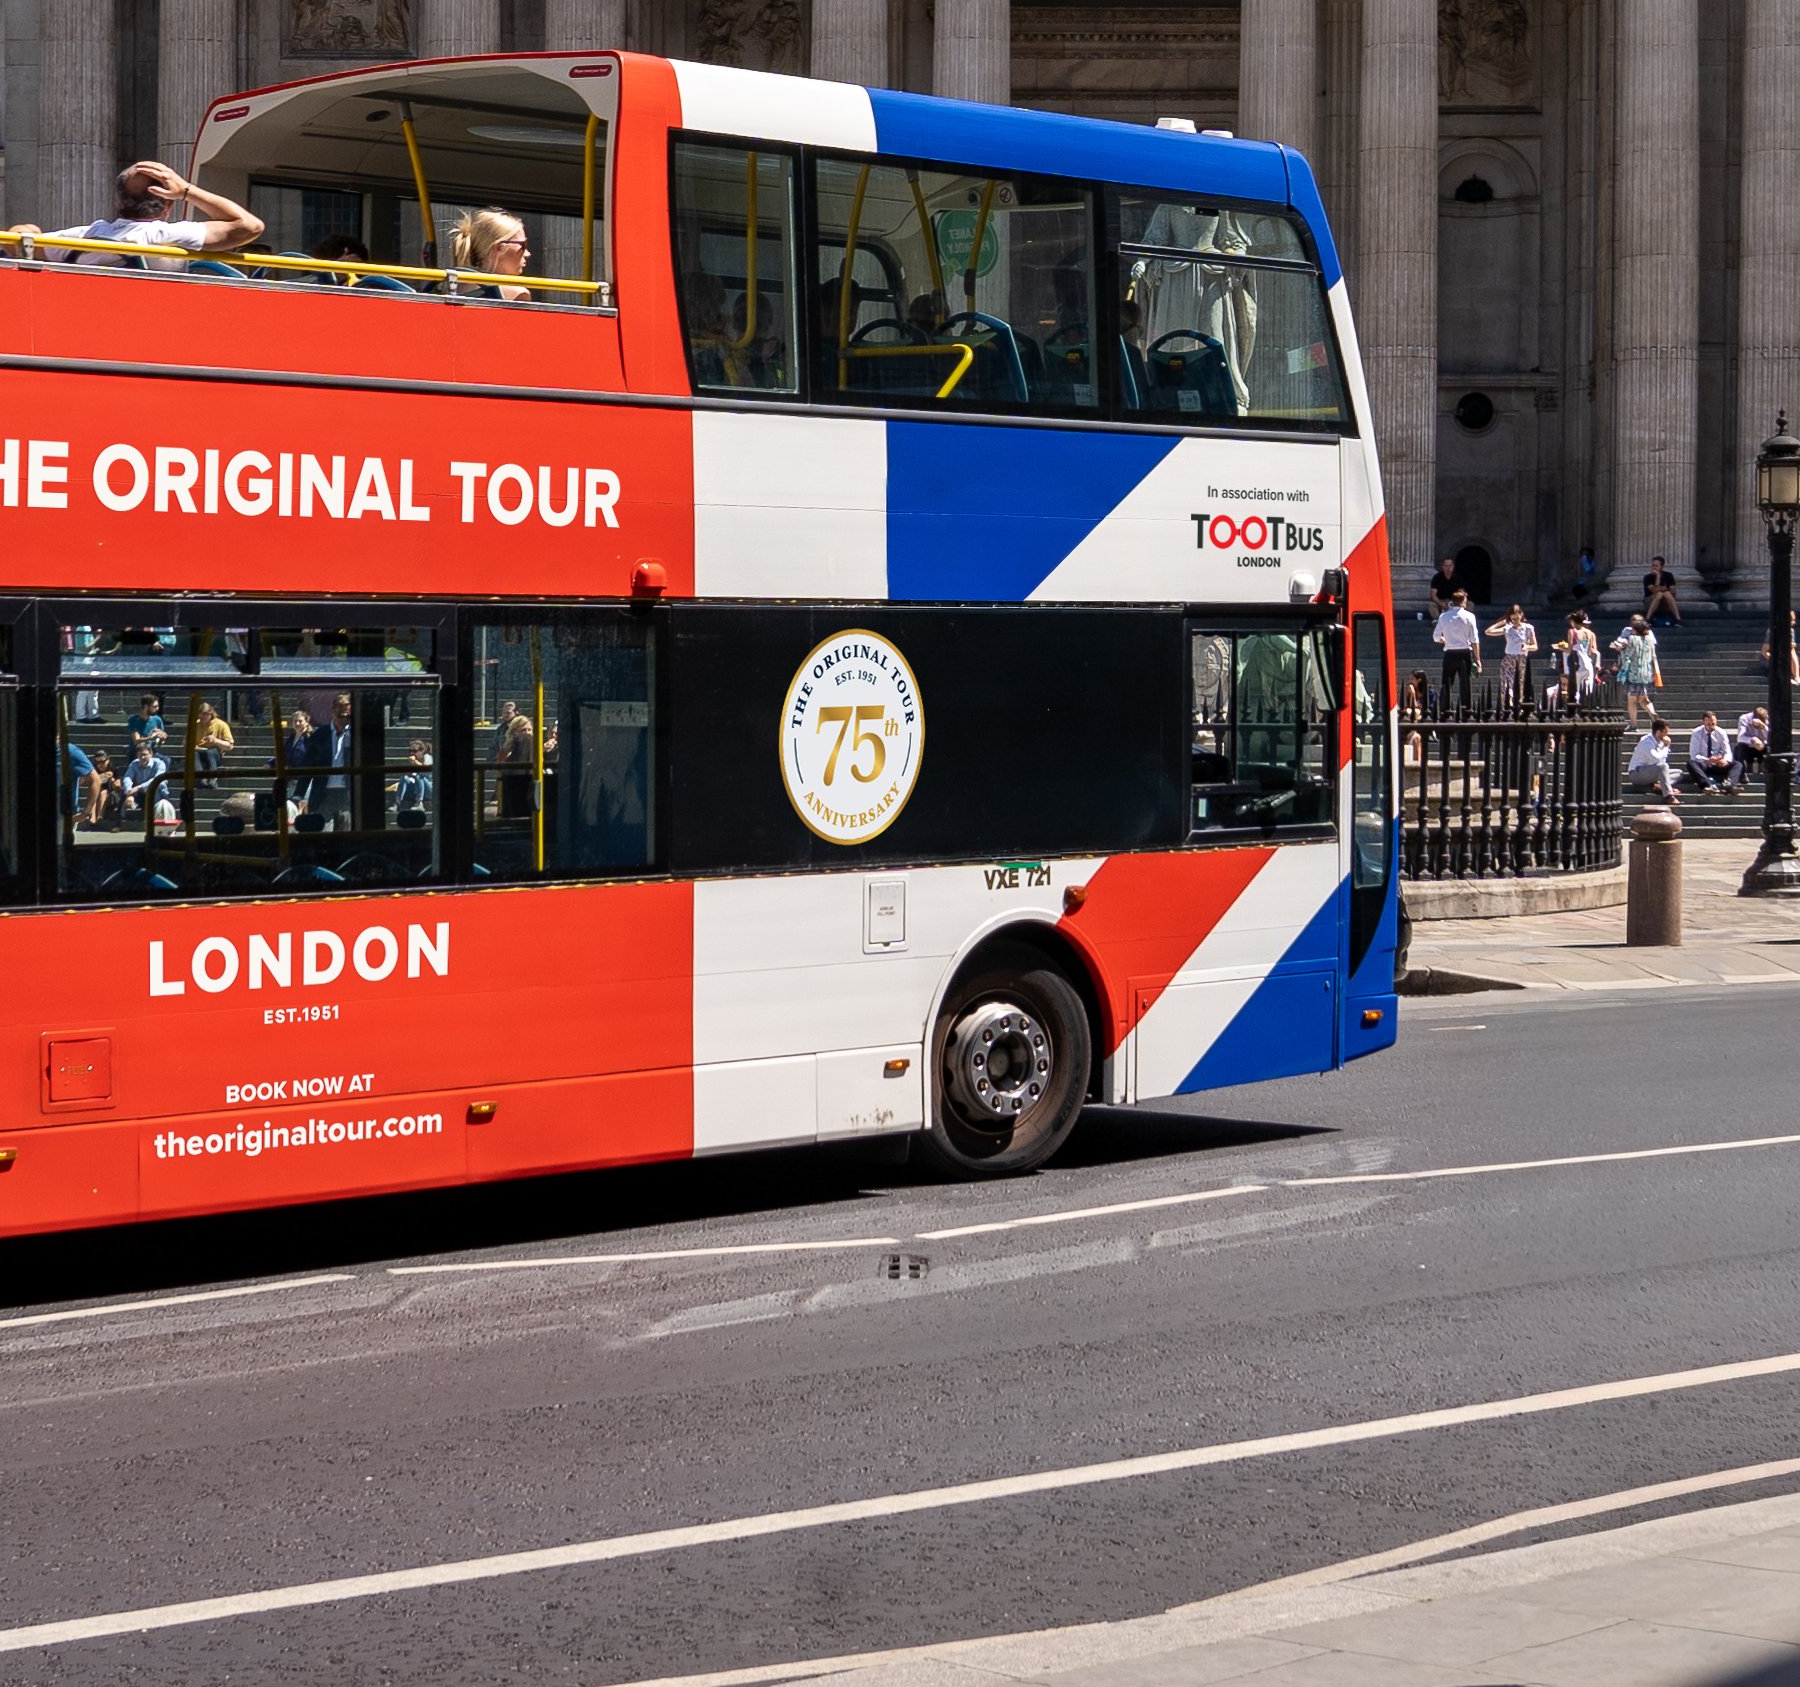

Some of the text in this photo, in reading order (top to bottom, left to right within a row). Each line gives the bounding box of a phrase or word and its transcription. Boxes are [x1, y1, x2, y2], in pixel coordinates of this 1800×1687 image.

[93, 443, 430, 522] ORIGINAL
[450, 461, 622, 529] TOUR
[1207, 485, 1310, 502] In association with
[1237, 556, 1281, 568] LONDON
[791, 644, 915, 729] THE ORIGINAL TOUR
[834, 669, 877, 686] EST. 1951
[803, 781, 900, 828] ANNIVERSARY
[983, 865, 1051, 890] VXE 721
[149, 922, 450, 997] LONDON
[264, 1005, 340, 1024] EST.1951
[226, 1074, 374, 1103] BOOK NOW AT
[154, 1114, 443, 1159] theoriginaltour.com
